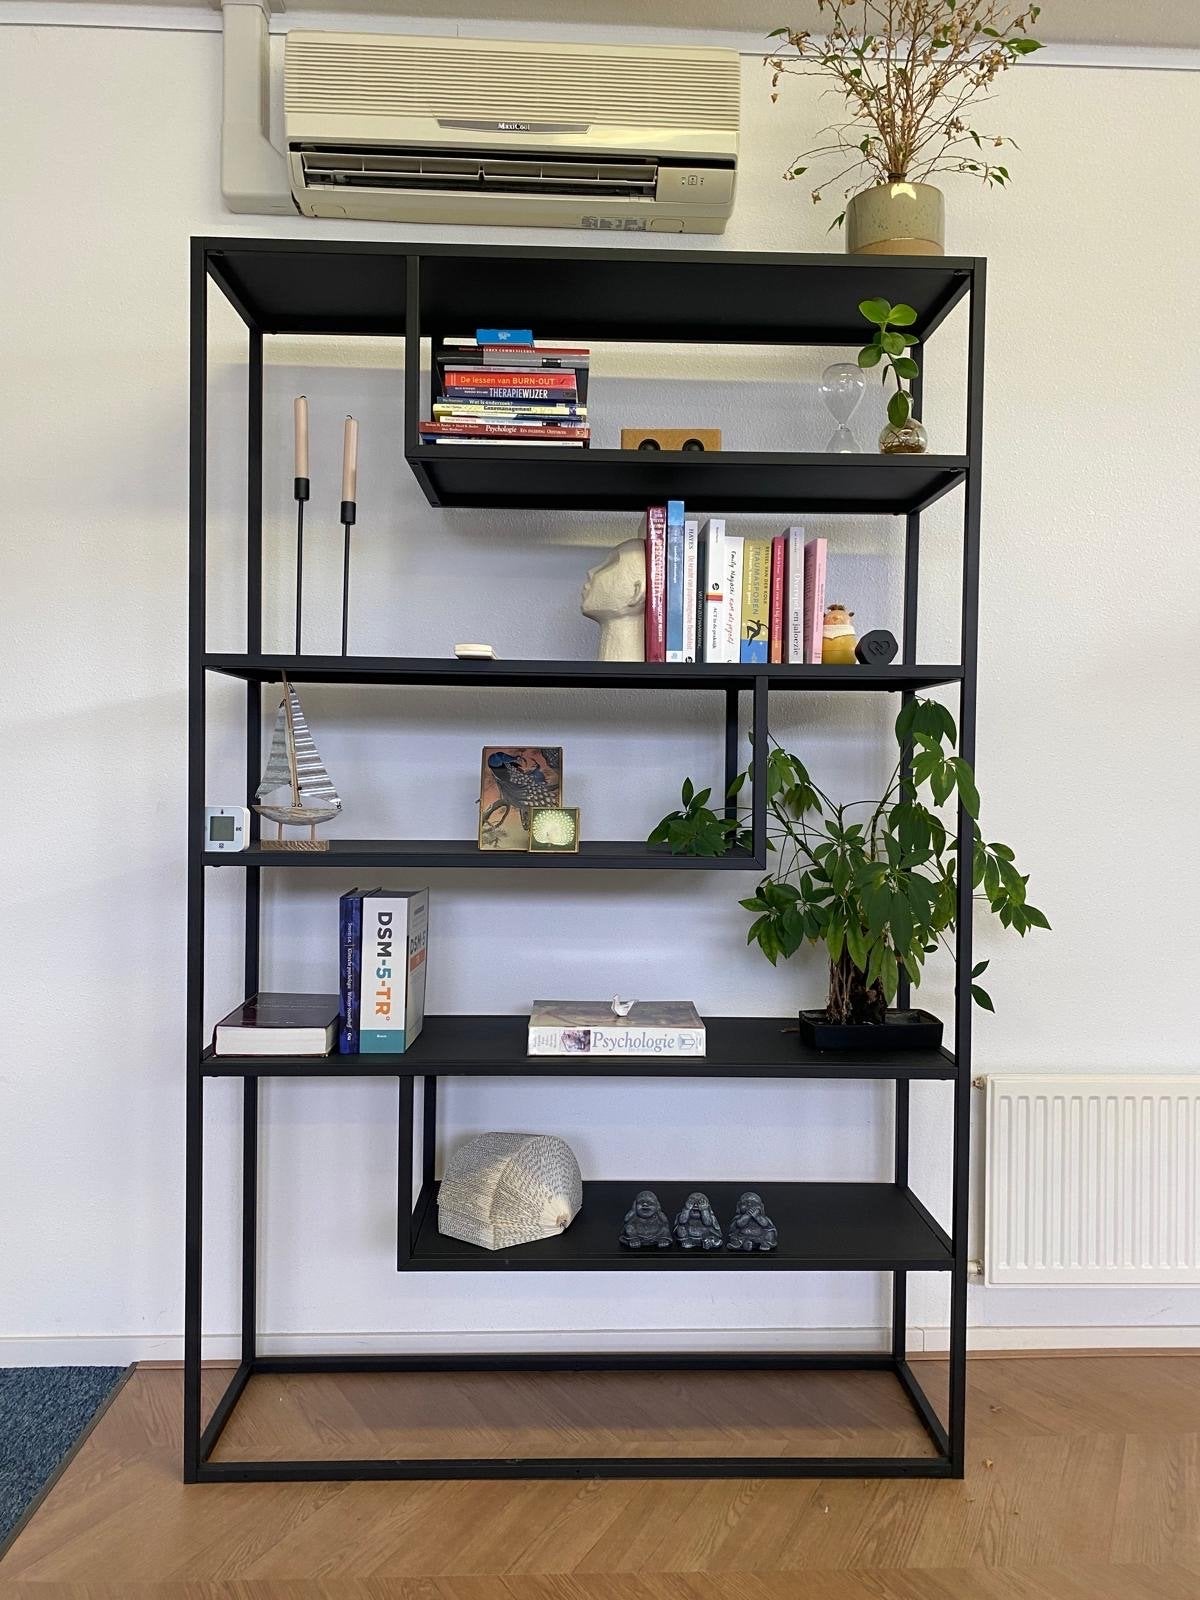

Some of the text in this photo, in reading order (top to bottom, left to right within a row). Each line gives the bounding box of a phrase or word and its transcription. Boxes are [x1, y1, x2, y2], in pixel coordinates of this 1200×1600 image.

[461, 376, 471, 384] De
[472, 377, 495, 385] lessen
[512, 377, 555, 386] BURN-OUT
[489, 387, 548, 400] THERAPIEWIJZER
[485, 424, 518, 434] Psychologie
[728, 550, 737, 568] Emily
[752, 546, 761, 615] TRAUMASPOREN
[793, 611, 799, 622] en
[592, 1031, 675, 1053] Psychologie
